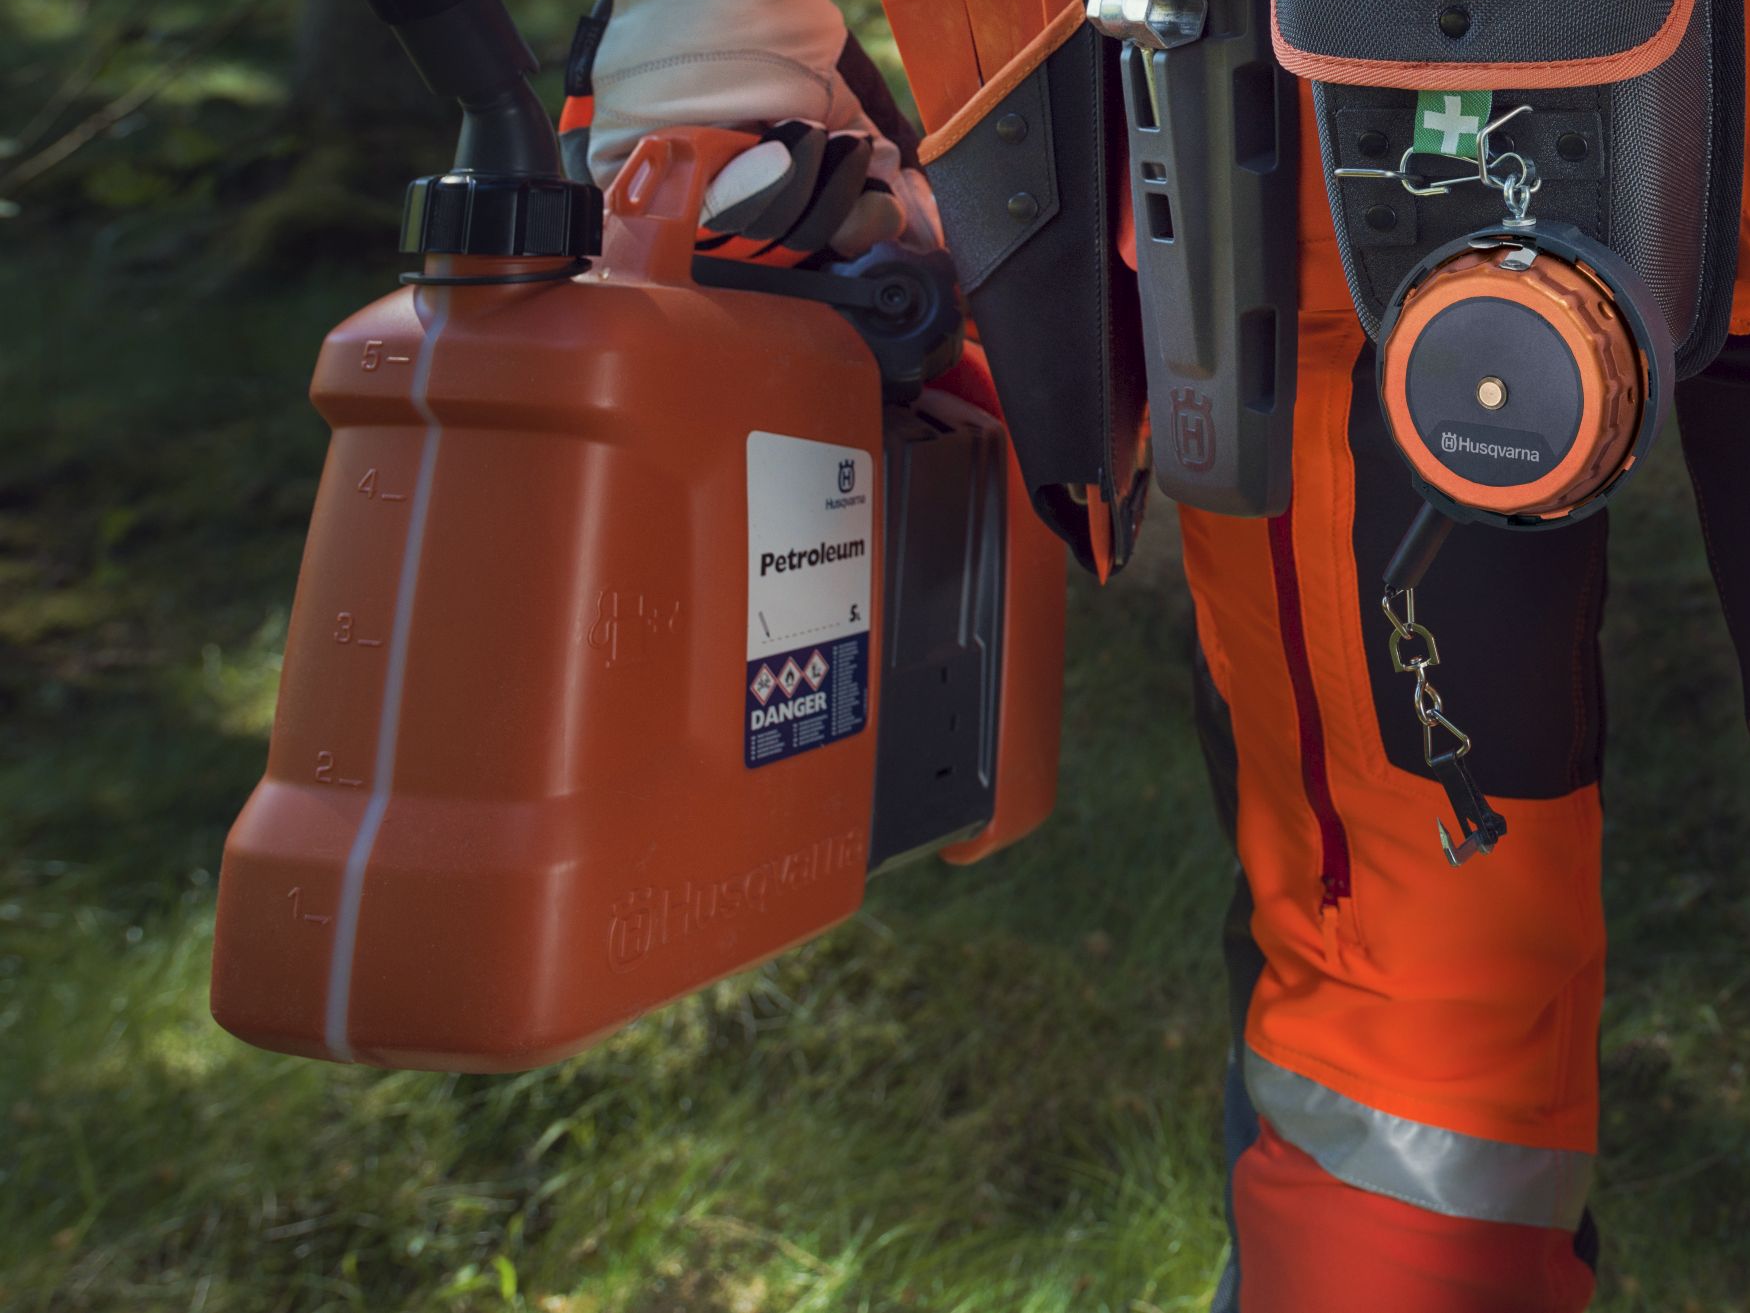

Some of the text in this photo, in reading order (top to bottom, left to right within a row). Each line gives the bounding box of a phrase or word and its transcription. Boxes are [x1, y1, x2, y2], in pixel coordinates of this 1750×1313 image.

[360, 339, 383, 370] 5
[1458, 436, 1541, 462] Husqvarna
[357, 468, 376, 500] 4
[825, 494, 867, 511] Husqvarna
[760, 538, 866, 578] Petroleum
[333, 611, 352, 643] 3
[751, 691, 829, 731] DANGER
[314, 750, 334, 784] 2
[661, 828, 868, 945] Husqvarna
